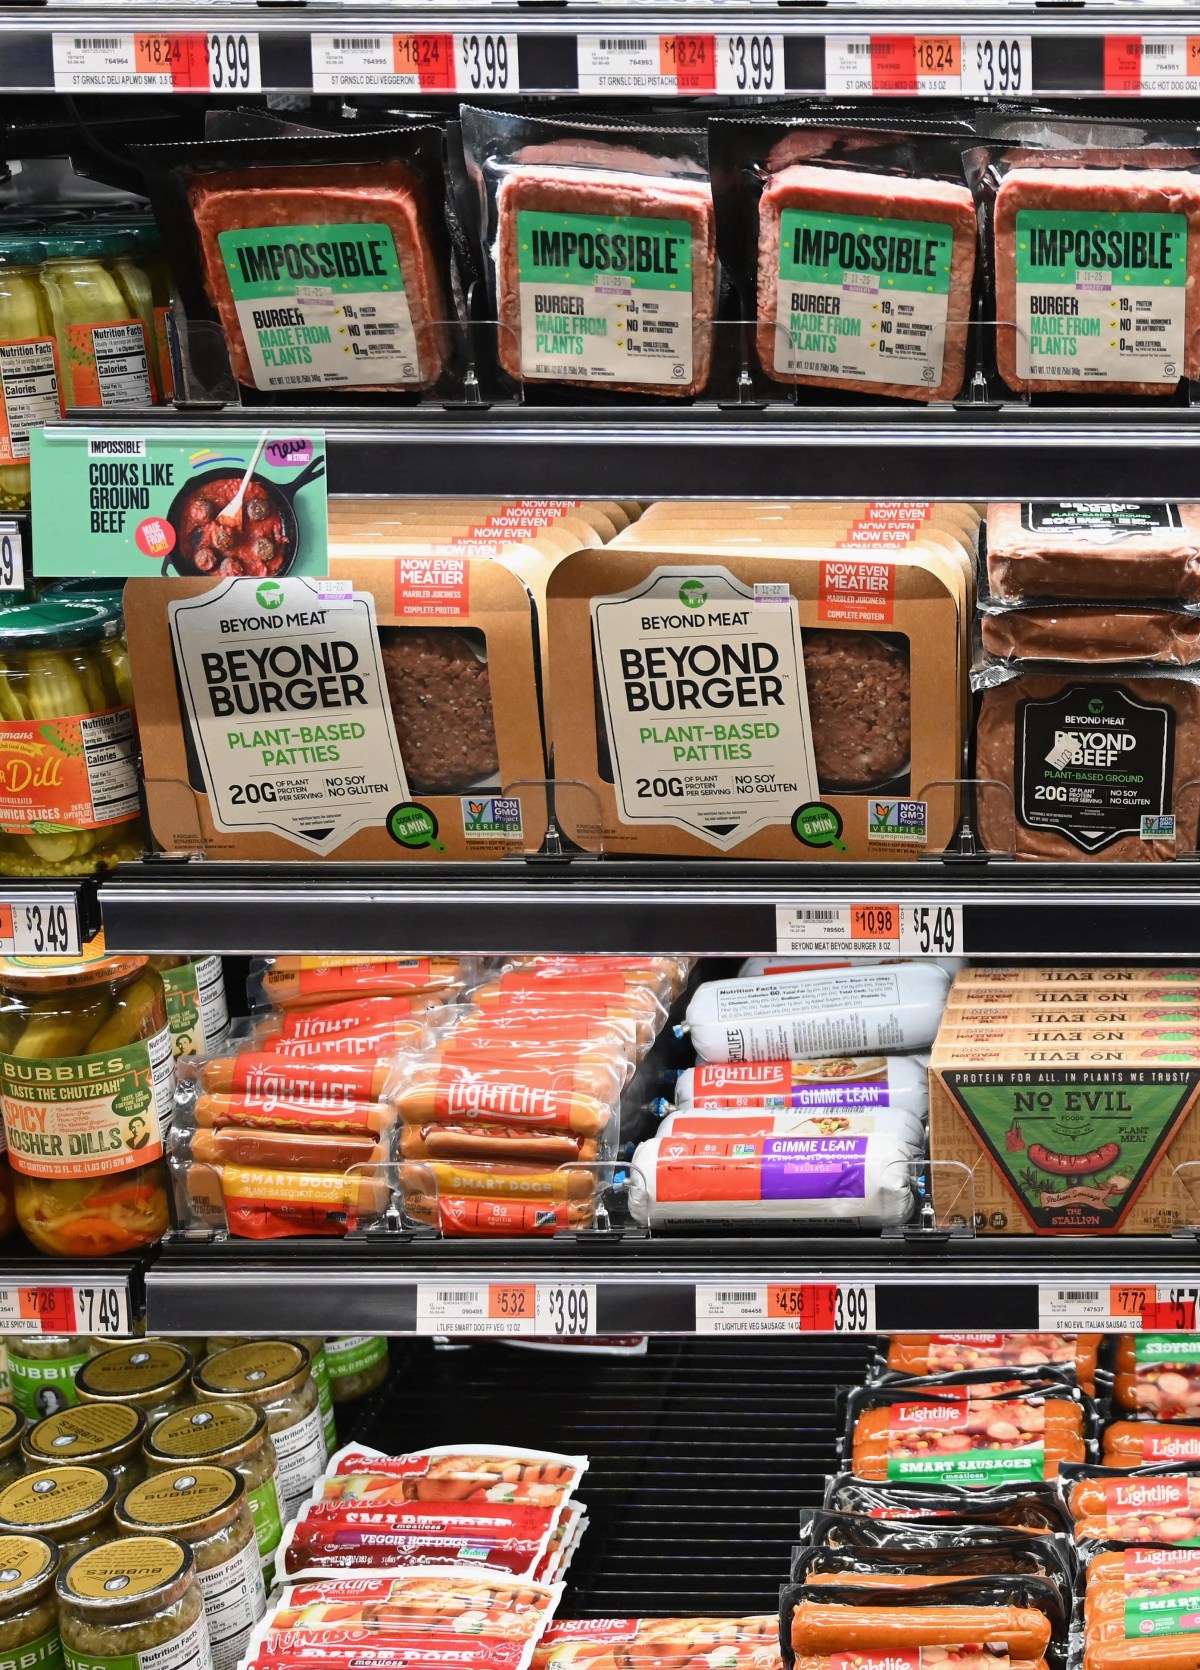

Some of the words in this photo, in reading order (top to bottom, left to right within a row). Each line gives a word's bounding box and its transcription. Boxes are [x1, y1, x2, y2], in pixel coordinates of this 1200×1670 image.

[140, 38, 181, 62] $18.24
[204, 35, 249, 88] $3.99
[463, 35, 508, 88] $3.99
[977, 41, 1021, 90] $3.99
[72, 76, 80, 85] ST
[82, 76, 105, 85] GRNSLC
[107, 76, 121, 85] DELI
[122, 76, 143, 85] APLWD
[145, 76, 156, 85] SMK
[532, 230, 684, 274] IMPOSSIBLE
[793, 228, 945, 277] IMPOSSIBLE
[1030, 228, 1179, 269] IMPOSSIBLE
[236, 241, 388, 283] IMPOSSIBLE
[791, 292, 840, 315] BURGER
[1030, 296, 1078, 315] BURGER
[252, 308, 305, 329] BURGER
[1030, 317, 1063, 335] MADE
[1067, 318, 1100, 336] FROM
[1119, 319, 1131, 331] NO
[93, 328, 123, 339] Nutrition
[125, 326, 142, 337] Facts
[1030, 336, 1077, 356] PLANTS
[98, 363, 127, 374] Calories
[91, 441, 143, 454] IMPOSSIBLE
[89, 463, 139, 486] COOKS
[143, 463, 174, 486] LIKE
[90, 487, 149, 510] GROUND
[90, 511, 126, 533] BEEF
[492, 517, 519, 527] NOW
[521, 517, 548, 527] EVEN
[825, 574, 889, 591] MEATIER
[220, 614, 284, 634] BEYOND
[287, 612, 327, 628] MEAT
[201, 640, 358, 686] BEYOND
[620, 643, 779, 680] BEYOND
[207, 674, 368, 717] BURGER
[624, 675, 785, 712] BURGER
[1065, 715, 1101, 724] BEYOND
[1102, 717, 1125, 725] MEAT
[227, 722, 365, 749] PLANT-BASED
[262, 745, 340, 767] PATTIES
[1071, 750, 1118, 767] BEEF
[7, 756, 63, 792] Dill
[735, 775, 750, 784] NO
[751, 774, 775, 783] SOY
[737, 785, 752, 794] NO
[754, 783, 797, 793] GLUTEN
[1034, 785, 1067, 802] 20G
[26, 905, 68, 952] $3.49
[856, 911, 892, 931] $10.98
[914, 906, 955, 953] $5.49
[791, 942, 814, 950] BEYOND
[814, 942, 830, 950] MEAT
[830, 942, 853, 950] BEYOND
[854, 942, 877, 950] BURGER
[884, 942, 891, 950] OZ
[4, 1058, 123, 1081] BUBBIES
[955, 1073, 1003, 1083] PROTEIN
[1010, 1073, 1031, 1083] FOR
[1065, 1072, 1076, 1083] IN
[1083, 1072, 1123, 1082] PLANTS
[1130, 1072, 1144, 1082] WE
[1151, 1072, 1190, 1083] TRUST!
[10, 1084, 35, 1099] TASTE
[38, 1088, 57, 1100] THE
[1064, 1091, 1132, 1111] EVIL
[70, 1127, 122, 1156] DILLS
[772, 1140, 818, 1153] GIMME
[820, 1139, 857, 1153] LEAN
[452, 1177, 504, 1190] SMART
[510, 1180, 553, 1192] DOGS
[1051, 1215, 1100, 1225] STALLION
[79, 1288, 120, 1332] $7.49
[498, 1292, 525, 1312] $5.32
[1118, 1292, 1145, 1310] $7.72
[549, 1289, 588, 1334] $3.99
[900, 1406, 960, 1421] Lightlife
[900, 1462, 952, 1473] SMART
[957, 1459, 1033, 1471] SAUSAGES
[945, 1471, 984, 1480] meatless
[144, 1487, 219, 1500] BUBBIES
[1116, 1485, 1181, 1505] Lightlife
[361, 1534, 408, 1546] VEGGIE
